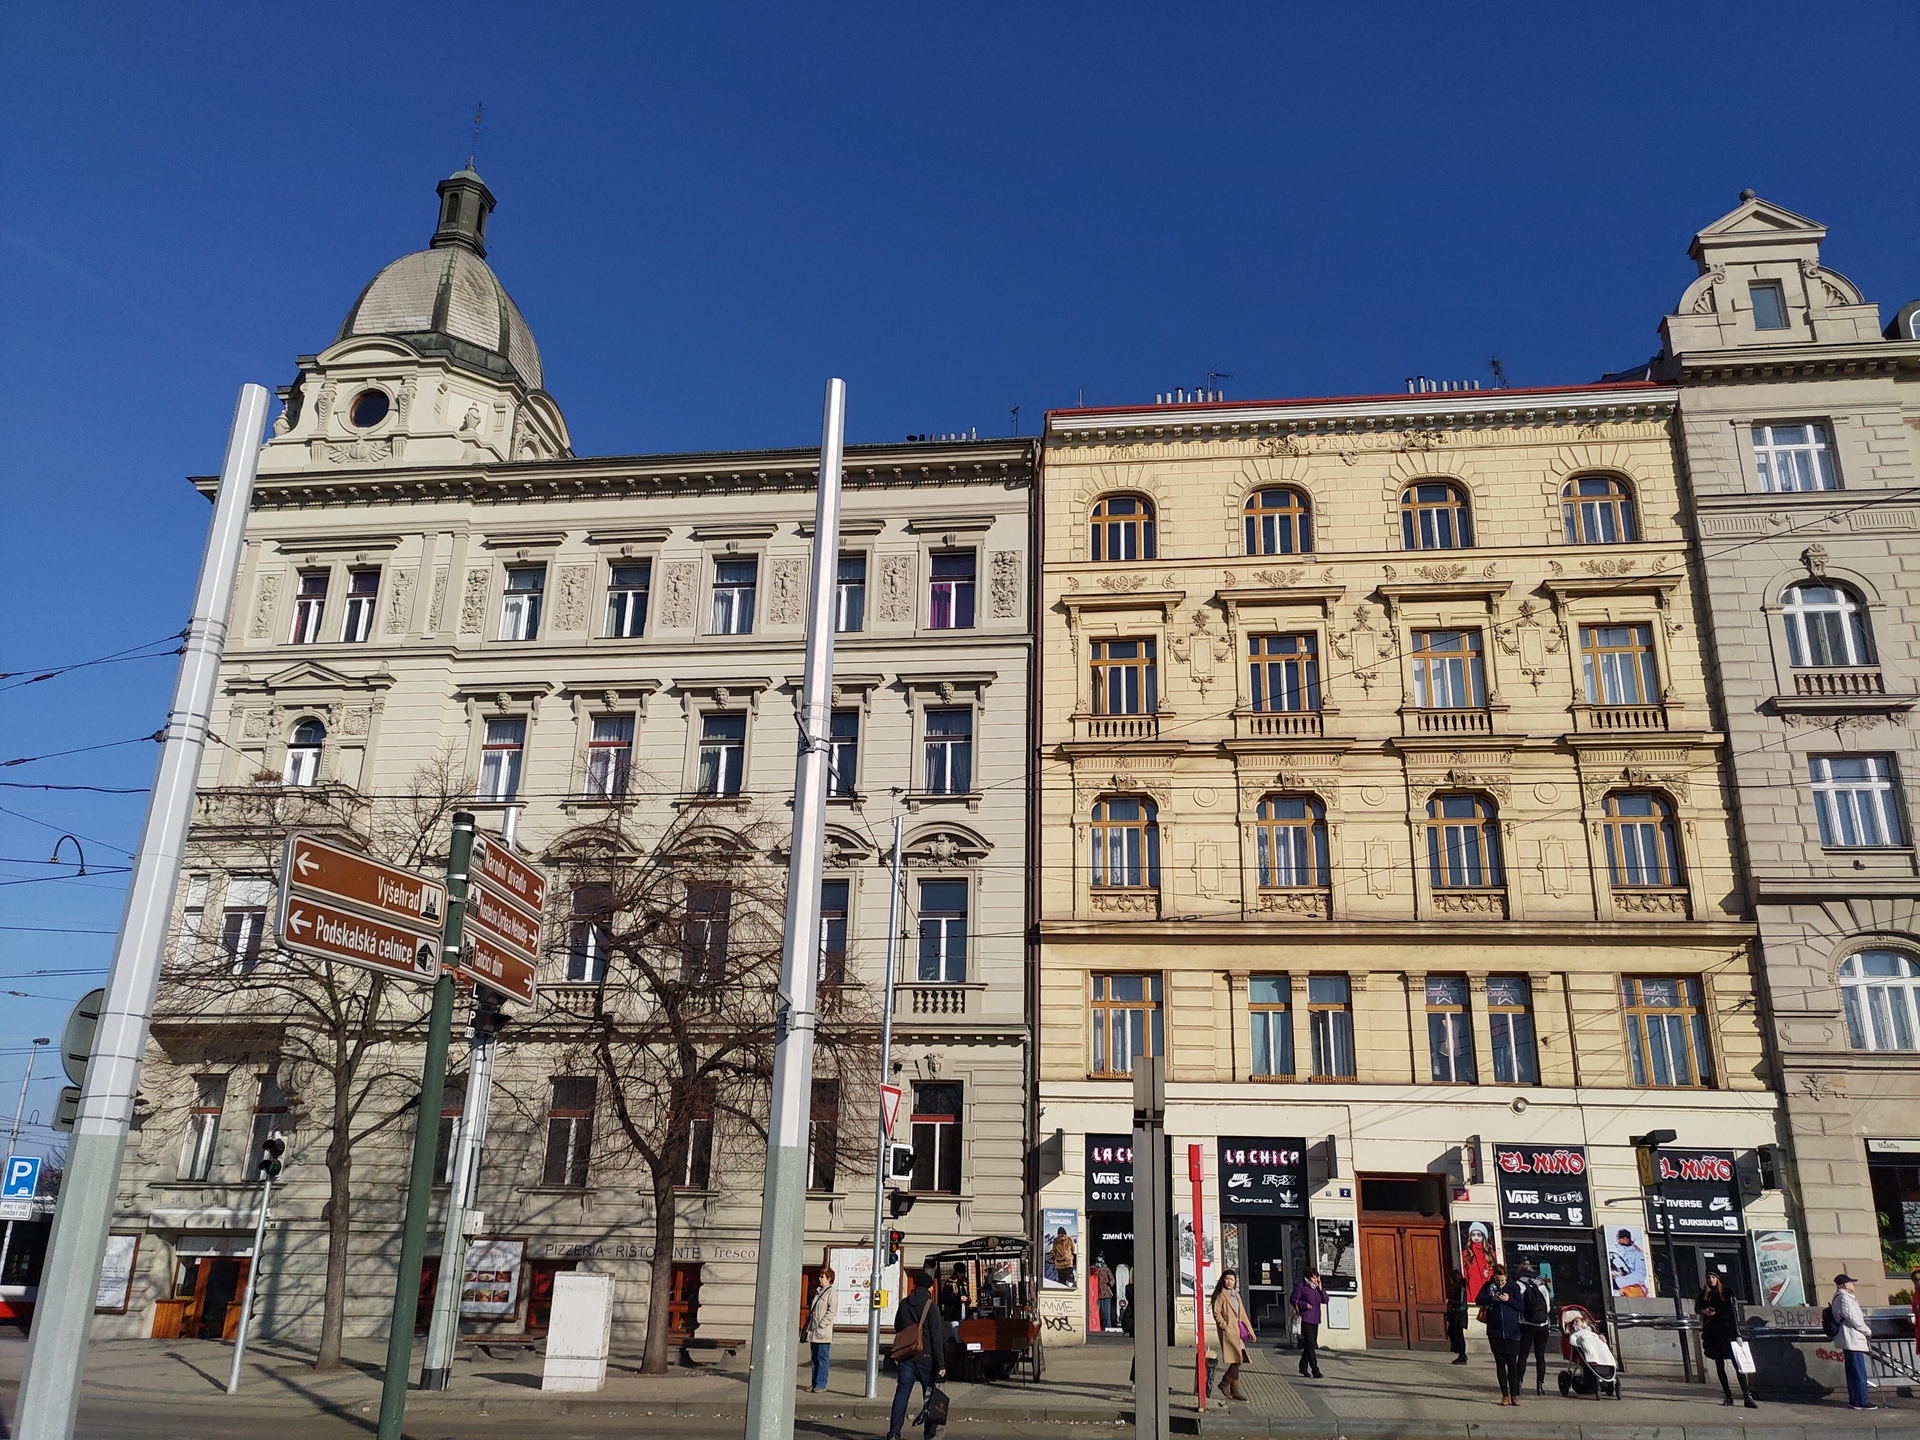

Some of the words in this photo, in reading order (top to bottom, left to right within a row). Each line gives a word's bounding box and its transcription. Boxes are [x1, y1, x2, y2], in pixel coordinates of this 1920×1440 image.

[484, 848, 508, 881] Národní
[507, 864, 527, 894] divadlo
[377, 875, 421, 911] Vyšehrad
[315, 914, 376, 955] Podskalská
[378, 935, 413, 965] celnice
[474, 944, 492, 973] Tančící
[1094, 1147, 1112, 1161] LA
[1226, 1149, 1245, 1164] LA
[1499, 1151, 1531, 1173] EL
[1532, 1150, 1585, 1174] NIÑO
[1679, 1155, 1734, 1181] NIÑO
[10, 1161, 32, 1186] P
[1092, 1172, 1120, 1184] VANS
[1232, 1173, 1249, 1181] NIKE
[1101, 1192, 1126, 1200] ROXY
[1343, 1189, 1348, 1197] 2
[1505, 1189, 1539, 1204] VANS
[1508, 1211, 1562, 1220] DAKINE
[1679, 1218, 1724, 1227] QUIKSILVER
[1102, 1232, 1122, 1240] ZIMNÍ
[545, 1244, 604, 1257] PIZZERIA
[714, 1246, 756, 1258] fresco
[1517, 1243, 1539, 1251] ZIMNÍ
[1540, 1243, 1576, 1252] VÝPRODEJ
[1760, 1259, 1778, 1268] RATED
[1774, 1264, 1788, 1272] STAR
